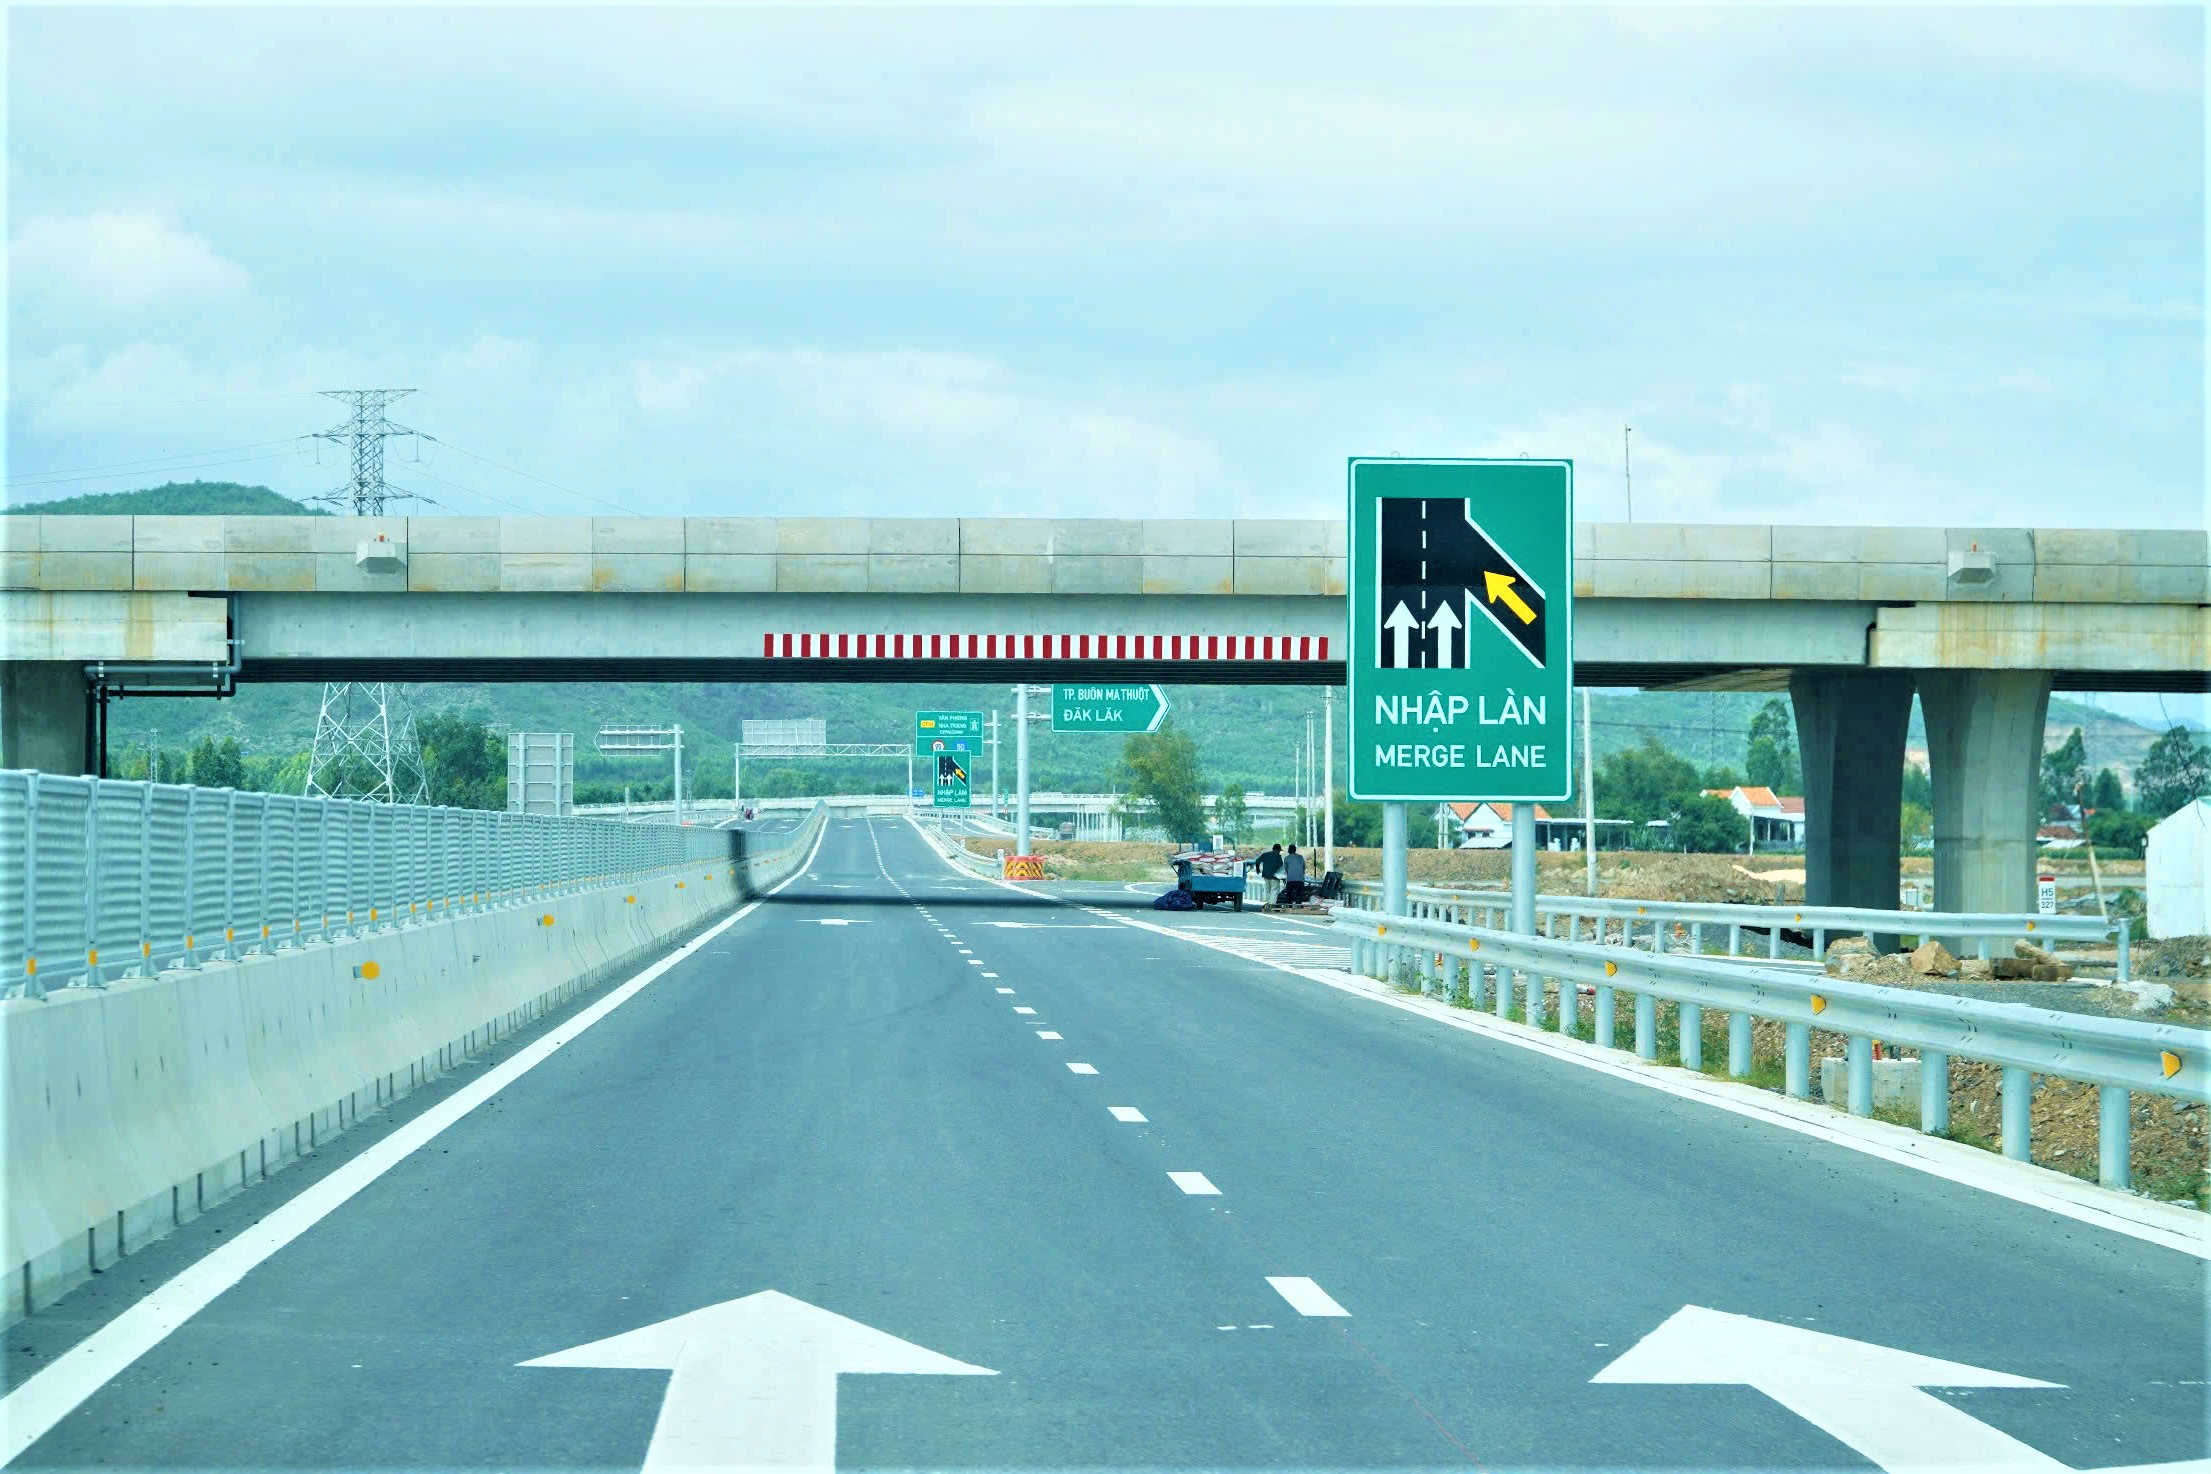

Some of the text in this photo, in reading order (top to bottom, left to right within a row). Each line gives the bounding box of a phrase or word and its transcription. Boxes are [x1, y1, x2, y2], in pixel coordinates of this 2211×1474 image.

[1063, 686, 1150, 702] TP. BUÔN MA THUỘT
[1375, 687, 1546, 733] NHẬP LÀN
[1375, 744, 1547, 768] MERGE LANE
[2041, 887, 2054, 897] H5
[2041, 901, 2054, 909] 327
